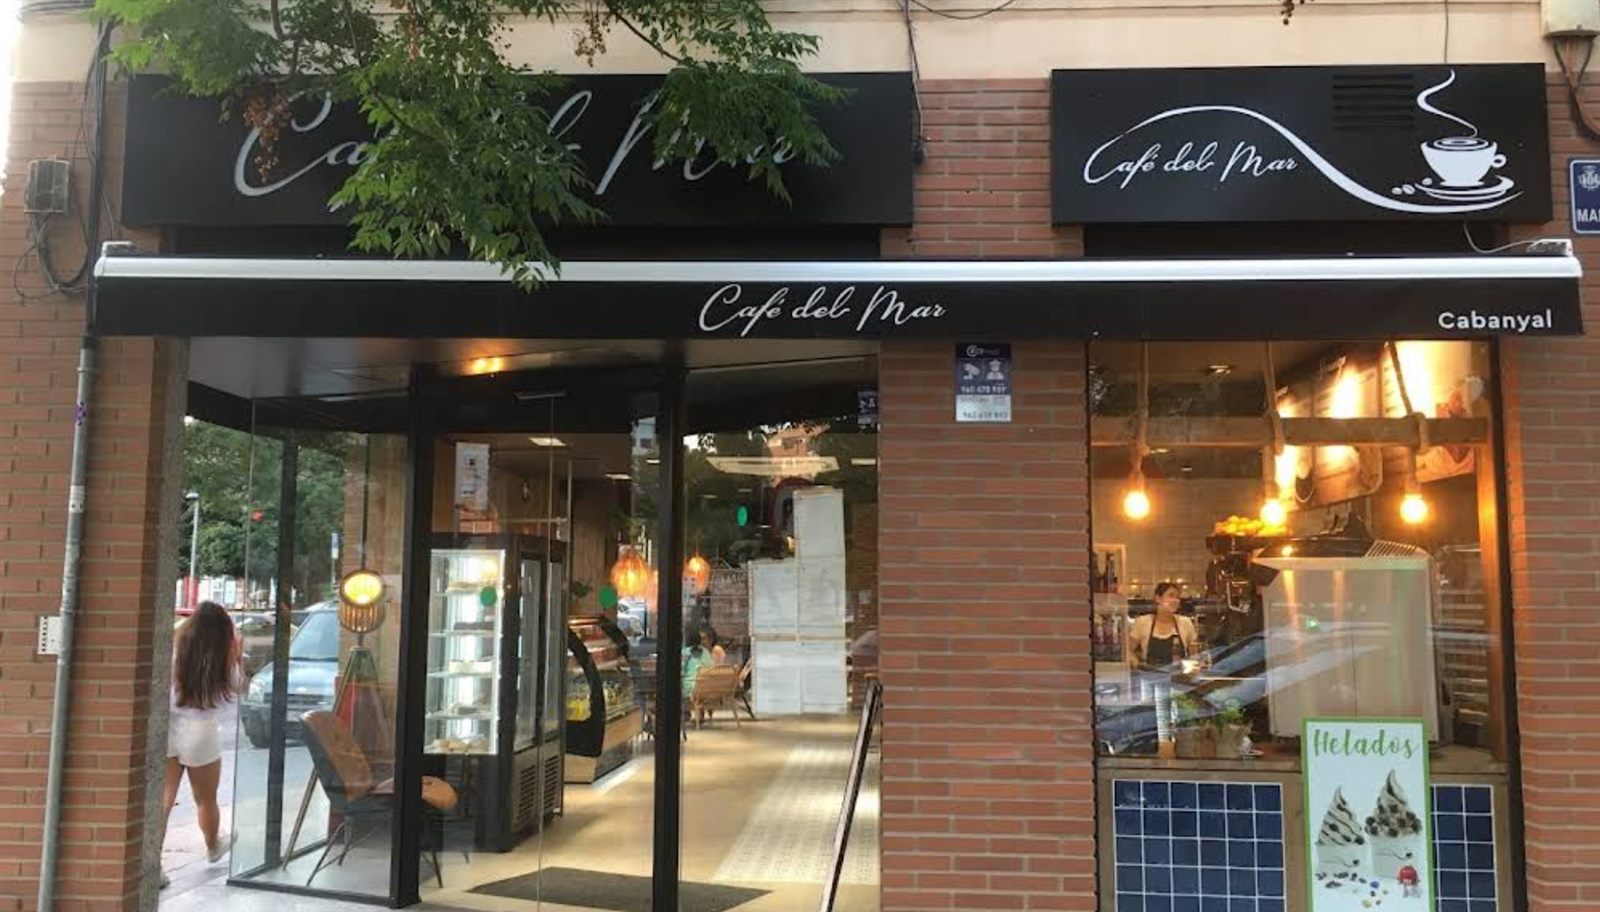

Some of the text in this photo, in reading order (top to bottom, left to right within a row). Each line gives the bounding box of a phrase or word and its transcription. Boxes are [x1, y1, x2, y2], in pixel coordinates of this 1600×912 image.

[1084, 134, 1298, 189] Café del Mar
[1577, 208, 1600, 222] MA
[699, 283, 946, 337] Café del Mar
[1438, 308, 1552, 333] Cabanyal
[1313, 729, 1416, 759] Helados
